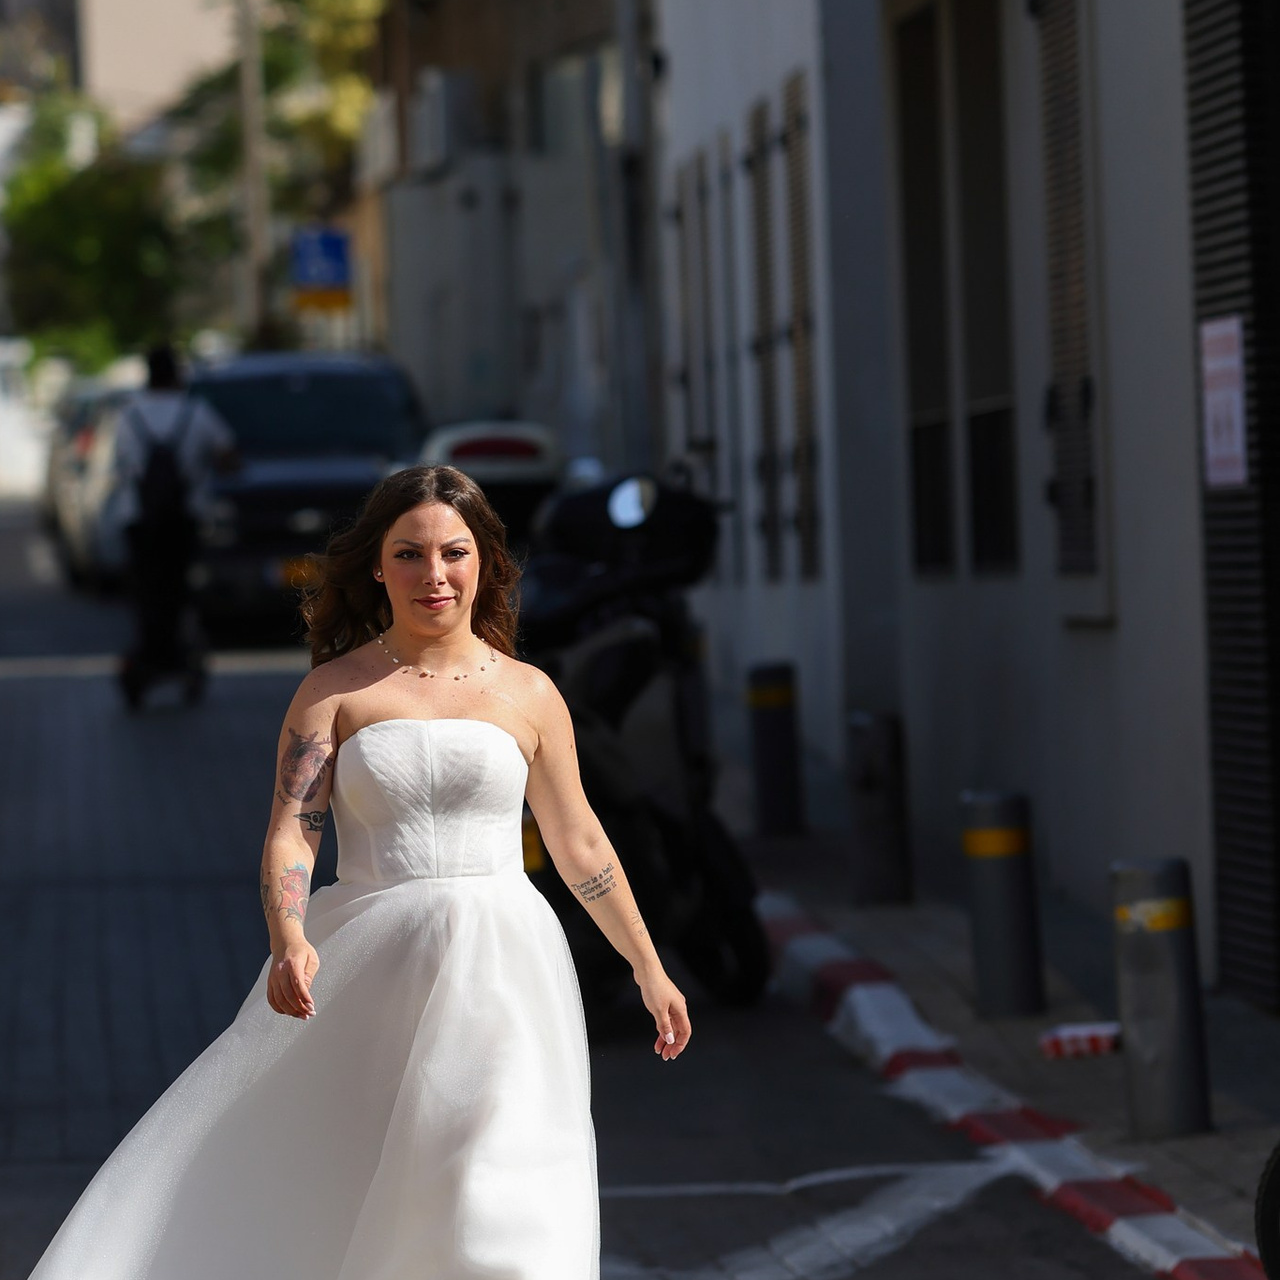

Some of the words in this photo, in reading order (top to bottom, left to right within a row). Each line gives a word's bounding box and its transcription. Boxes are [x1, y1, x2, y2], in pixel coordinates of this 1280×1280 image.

[571, 880, 591, 891] There
[590, 876, 598, 884] is
[601, 862, 615, 876] hell
[579, 882, 602, 896] believe
[603, 874, 614, 885] me
[596, 887, 611, 899] seen
